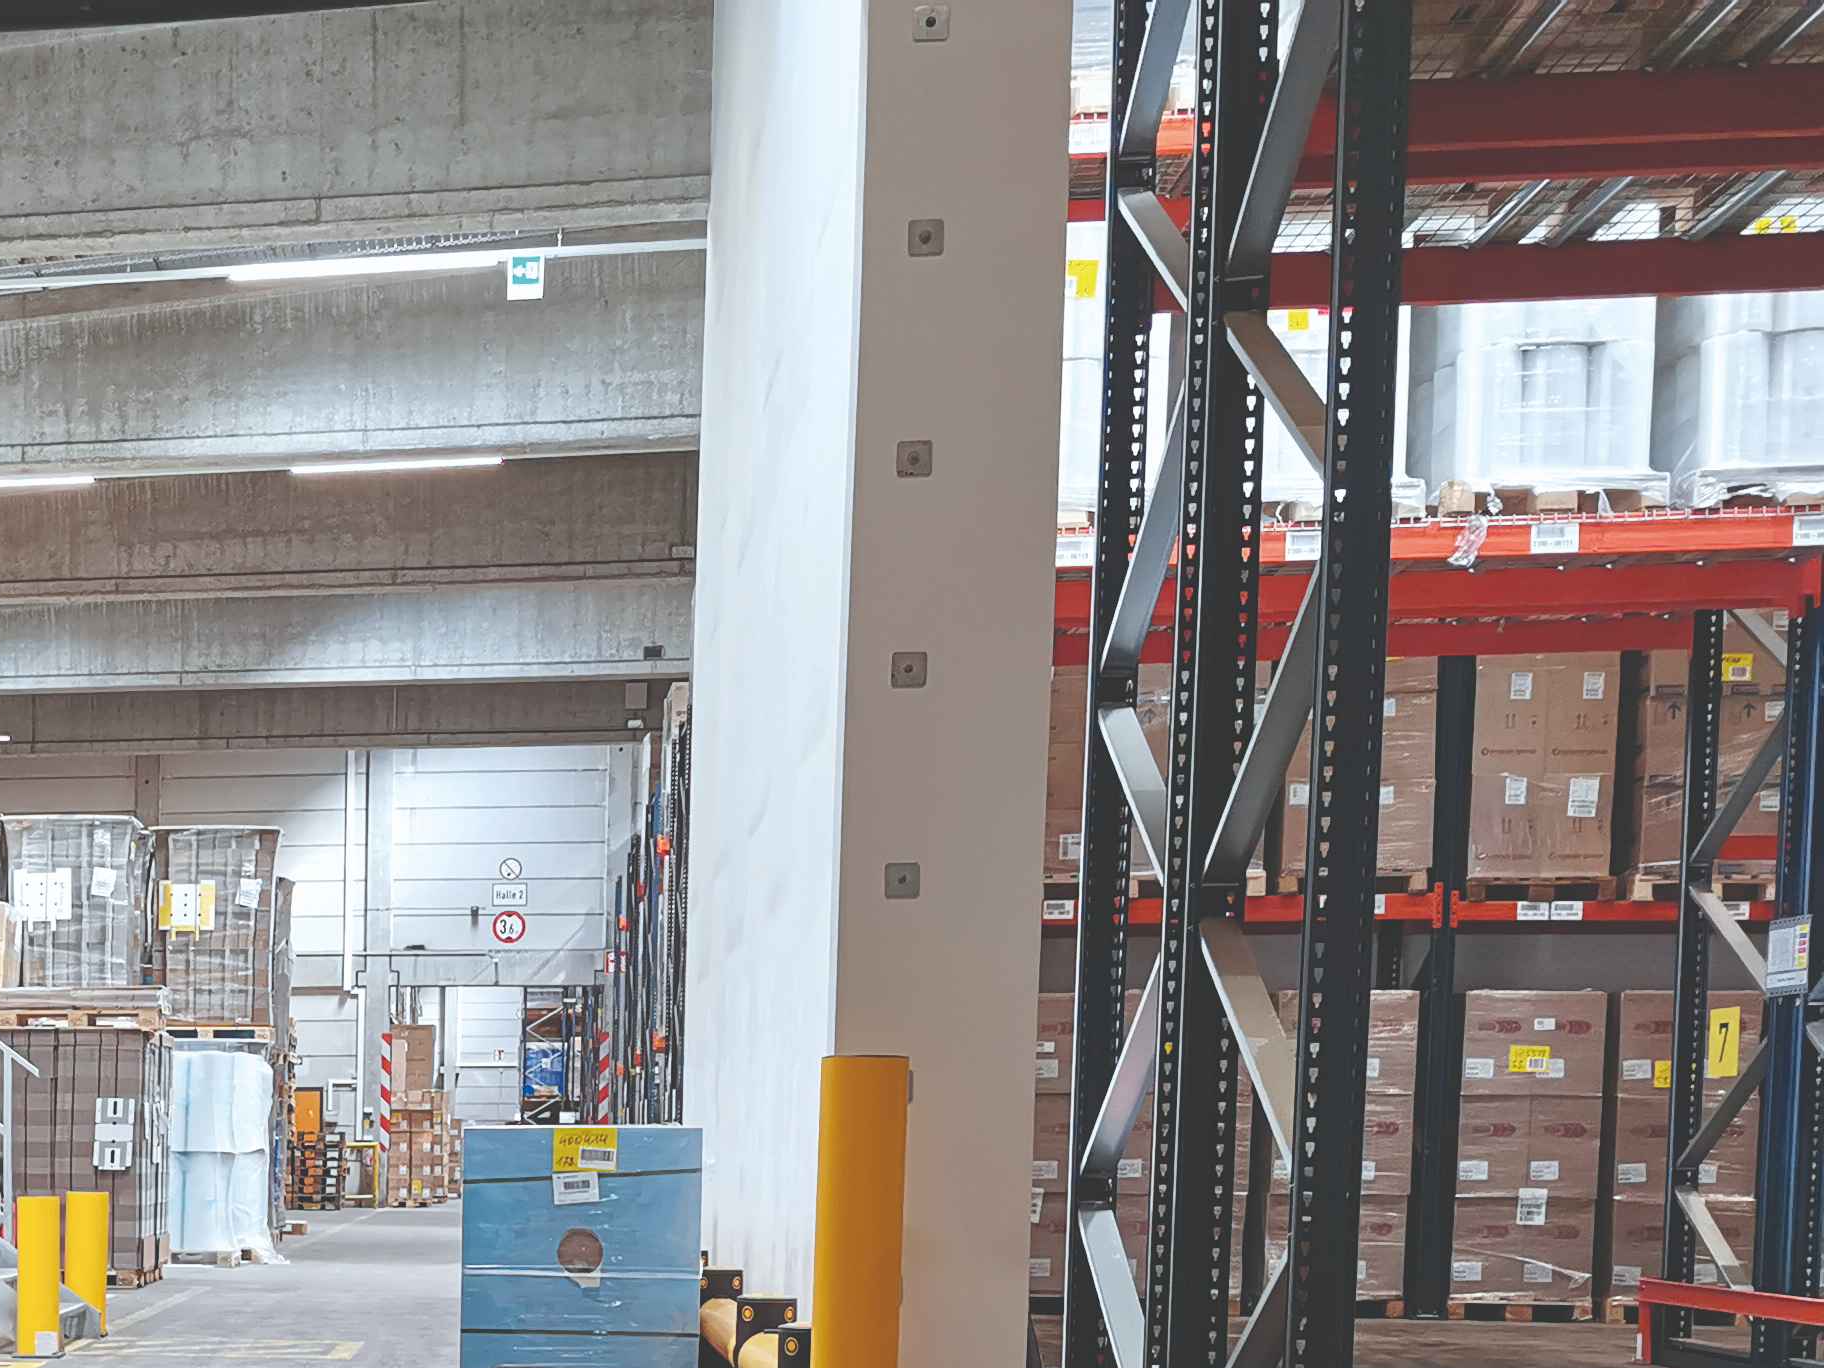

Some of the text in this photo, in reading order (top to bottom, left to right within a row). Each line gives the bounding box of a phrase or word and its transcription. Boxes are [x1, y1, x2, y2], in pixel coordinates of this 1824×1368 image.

[496, 890, 524, 899] Halle 2
[1718, 1022, 1730, 1064] 7
